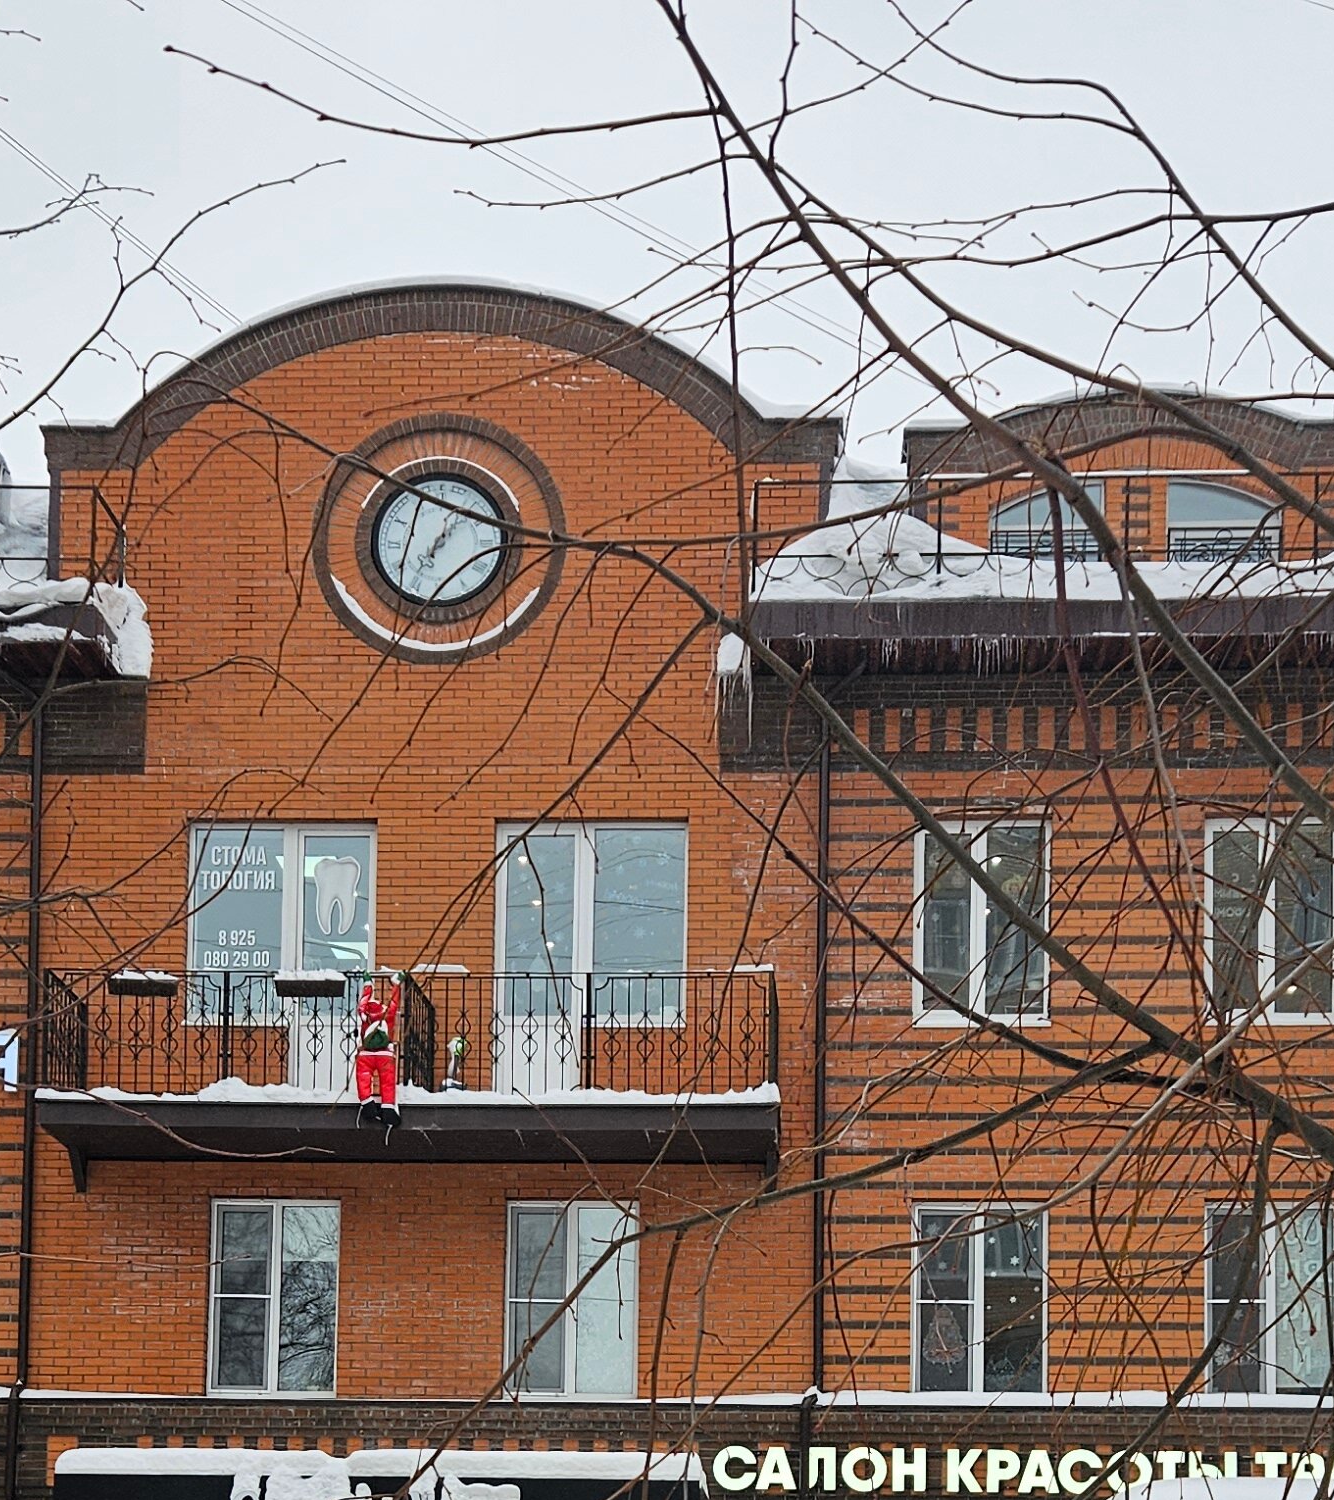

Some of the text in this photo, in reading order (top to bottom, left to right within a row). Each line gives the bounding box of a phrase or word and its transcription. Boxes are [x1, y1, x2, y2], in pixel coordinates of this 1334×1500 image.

[210, 845, 267, 866] СТОМА
[200, 870, 276, 890] ТОЛОГИЯ
[218, 929, 256, 946] 8 925
[203, 950, 270, 967] 080 29 00
[713, 1445, 926, 1492] САЛОН
[946, 1448, 1238, 1494] КРАСОТЫ
